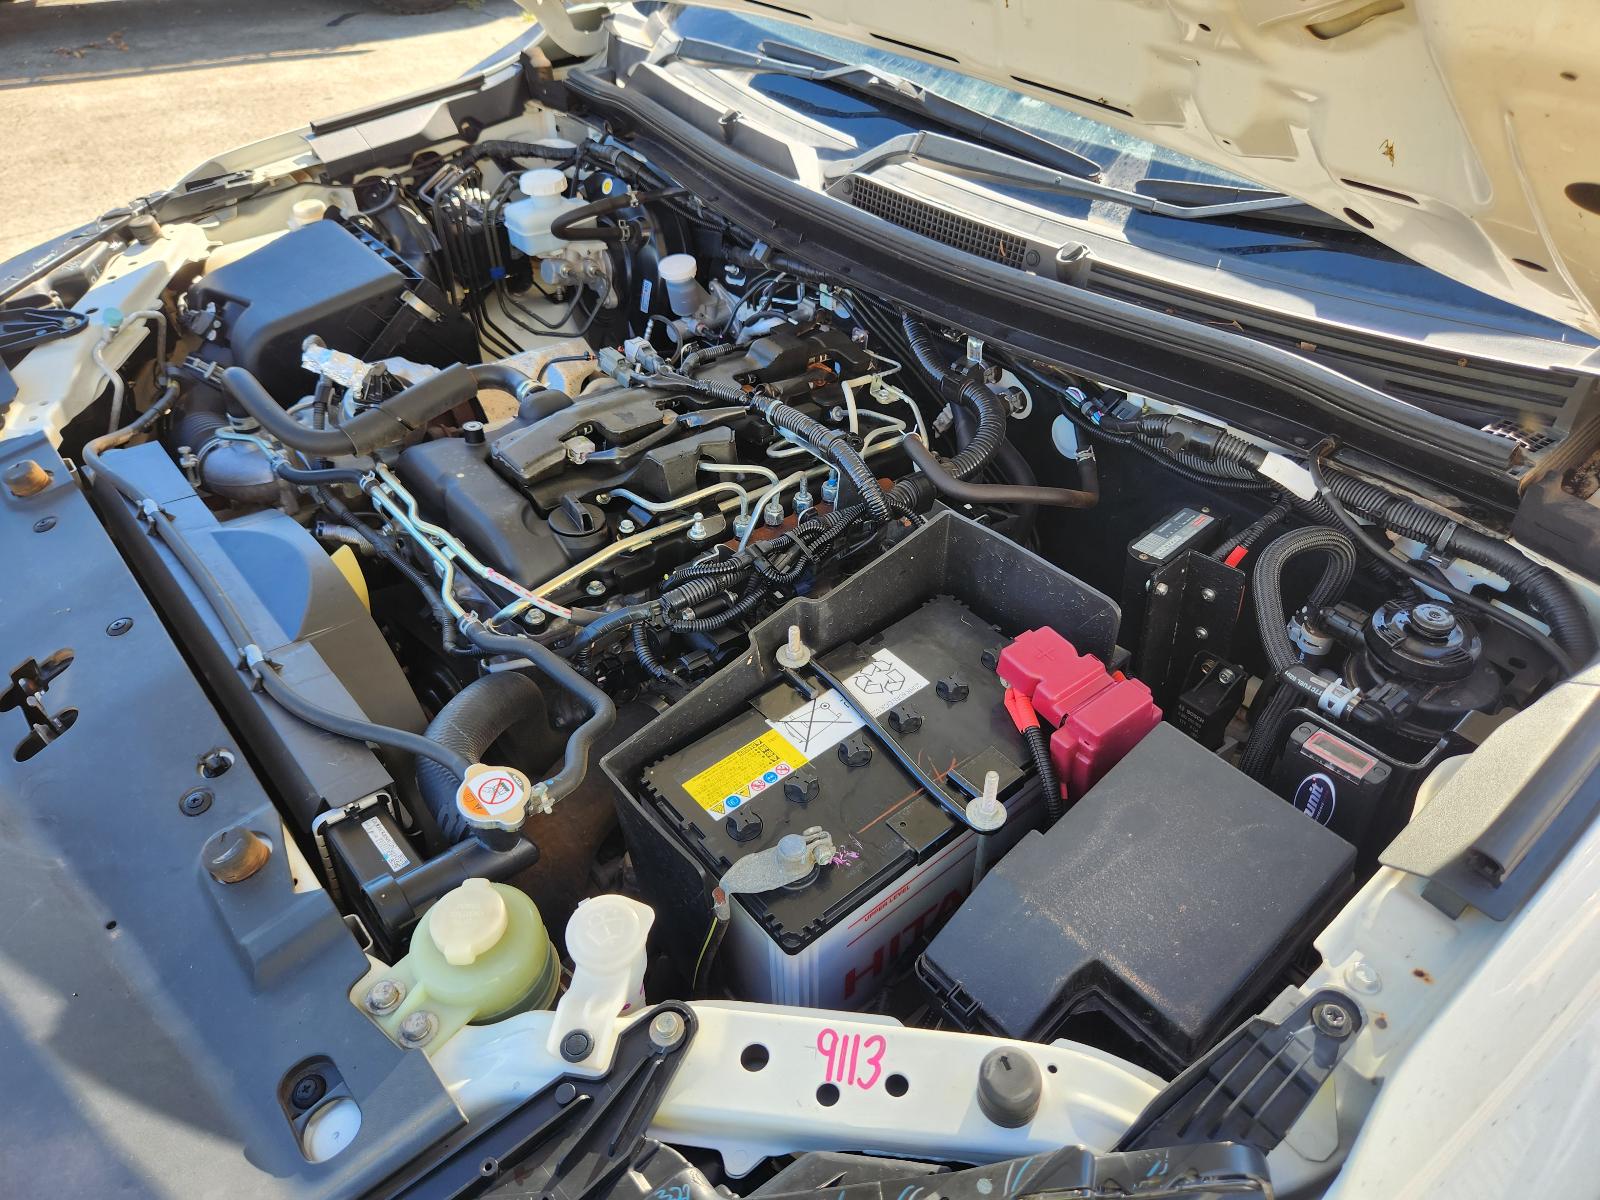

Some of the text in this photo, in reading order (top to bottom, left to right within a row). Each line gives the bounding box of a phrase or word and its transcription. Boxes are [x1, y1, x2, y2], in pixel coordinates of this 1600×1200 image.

[1303, 781, 1324, 818] unit
[864, 885, 911, 922] UPPER LEVEL
[817, 1028, 887, 1090] 9113
